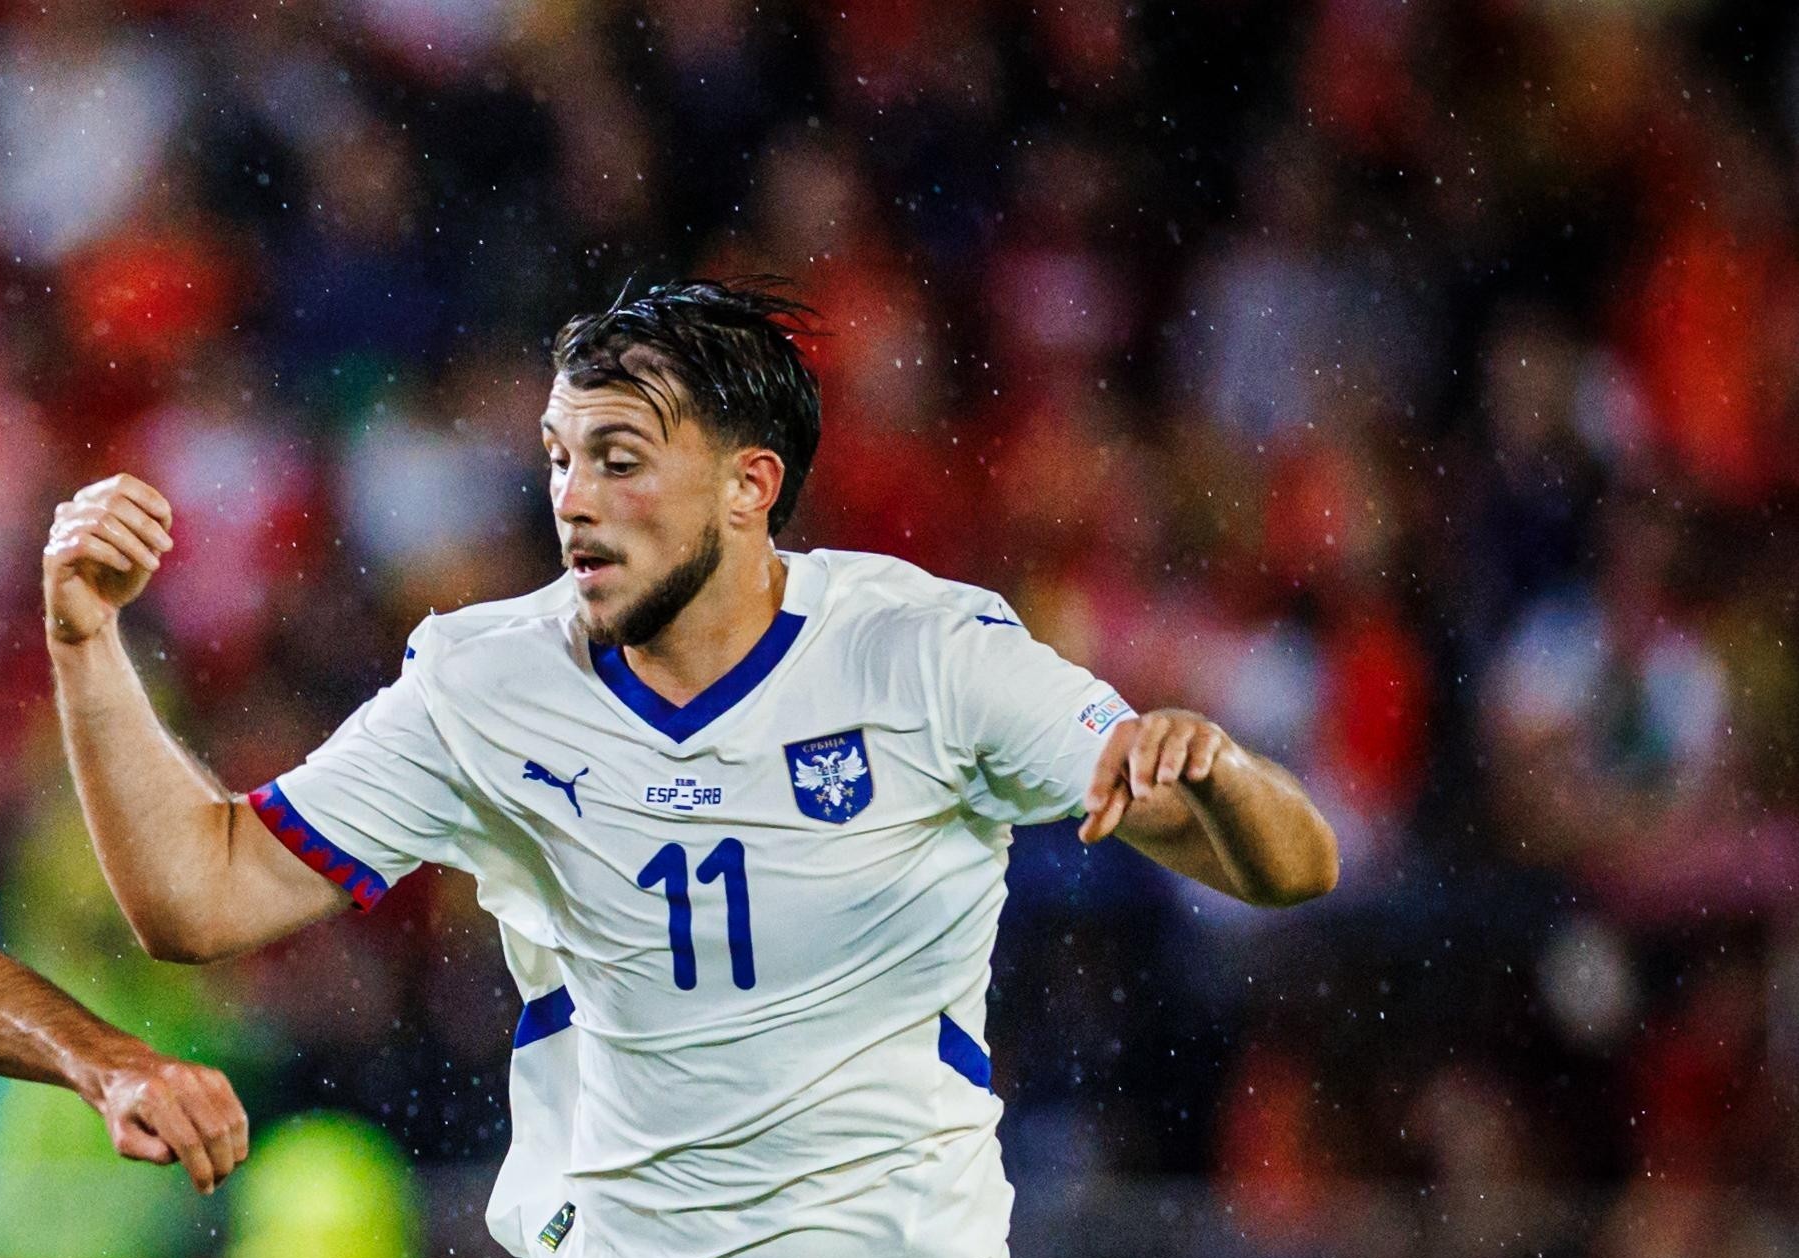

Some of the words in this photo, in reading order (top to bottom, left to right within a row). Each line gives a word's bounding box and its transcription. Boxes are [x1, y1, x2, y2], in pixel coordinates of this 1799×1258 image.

[646, 787, 678, 803] ESP
[692, 787, 722, 805] SRB
[637, 837, 756, 991] 11
